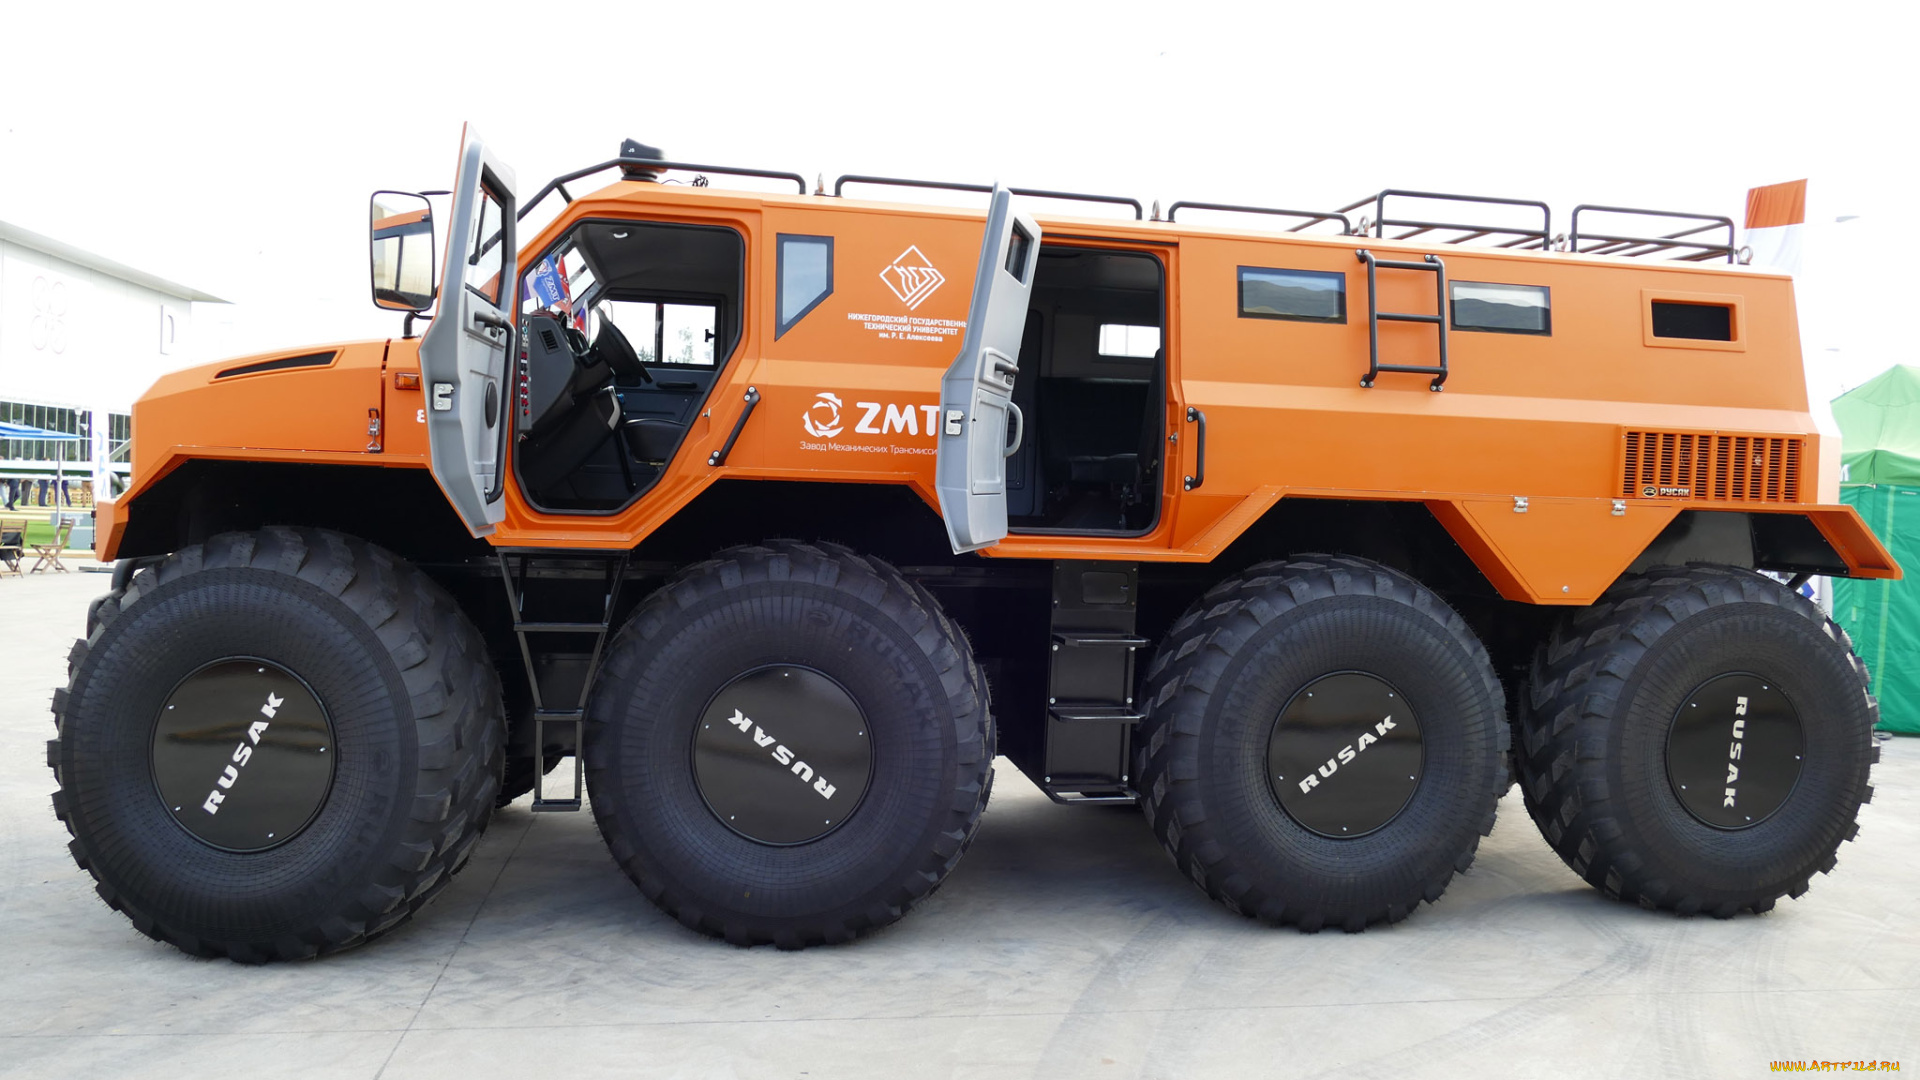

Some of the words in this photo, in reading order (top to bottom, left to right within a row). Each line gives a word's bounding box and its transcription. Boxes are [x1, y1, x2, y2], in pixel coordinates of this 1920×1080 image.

[847, 312, 908, 324] НИЖЕГОРОДСКИЙ
[908, 317, 968, 328] ГОСУДАРСТВЕНН
[864, 321, 912, 332] ТЕХНИЧЕСКИЙ
[912, 325, 958, 336] УНИВЕРСИТЕТ
[854, 401, 940, 437] ZMT
[799, 440, 827, 452] Завод
[828, 442, 888, 453] Механических
[890, 444, 938, 456] Трансмисси
[1660, 487, 1690, 497] РУСАК
[202, 691, 285, 815] RUSAK
[727, 708, 837, 800] RUSAK
[1298, 715, 1397, 794] RUSAK
[1723, 696, 1748, 808] RUSAK
